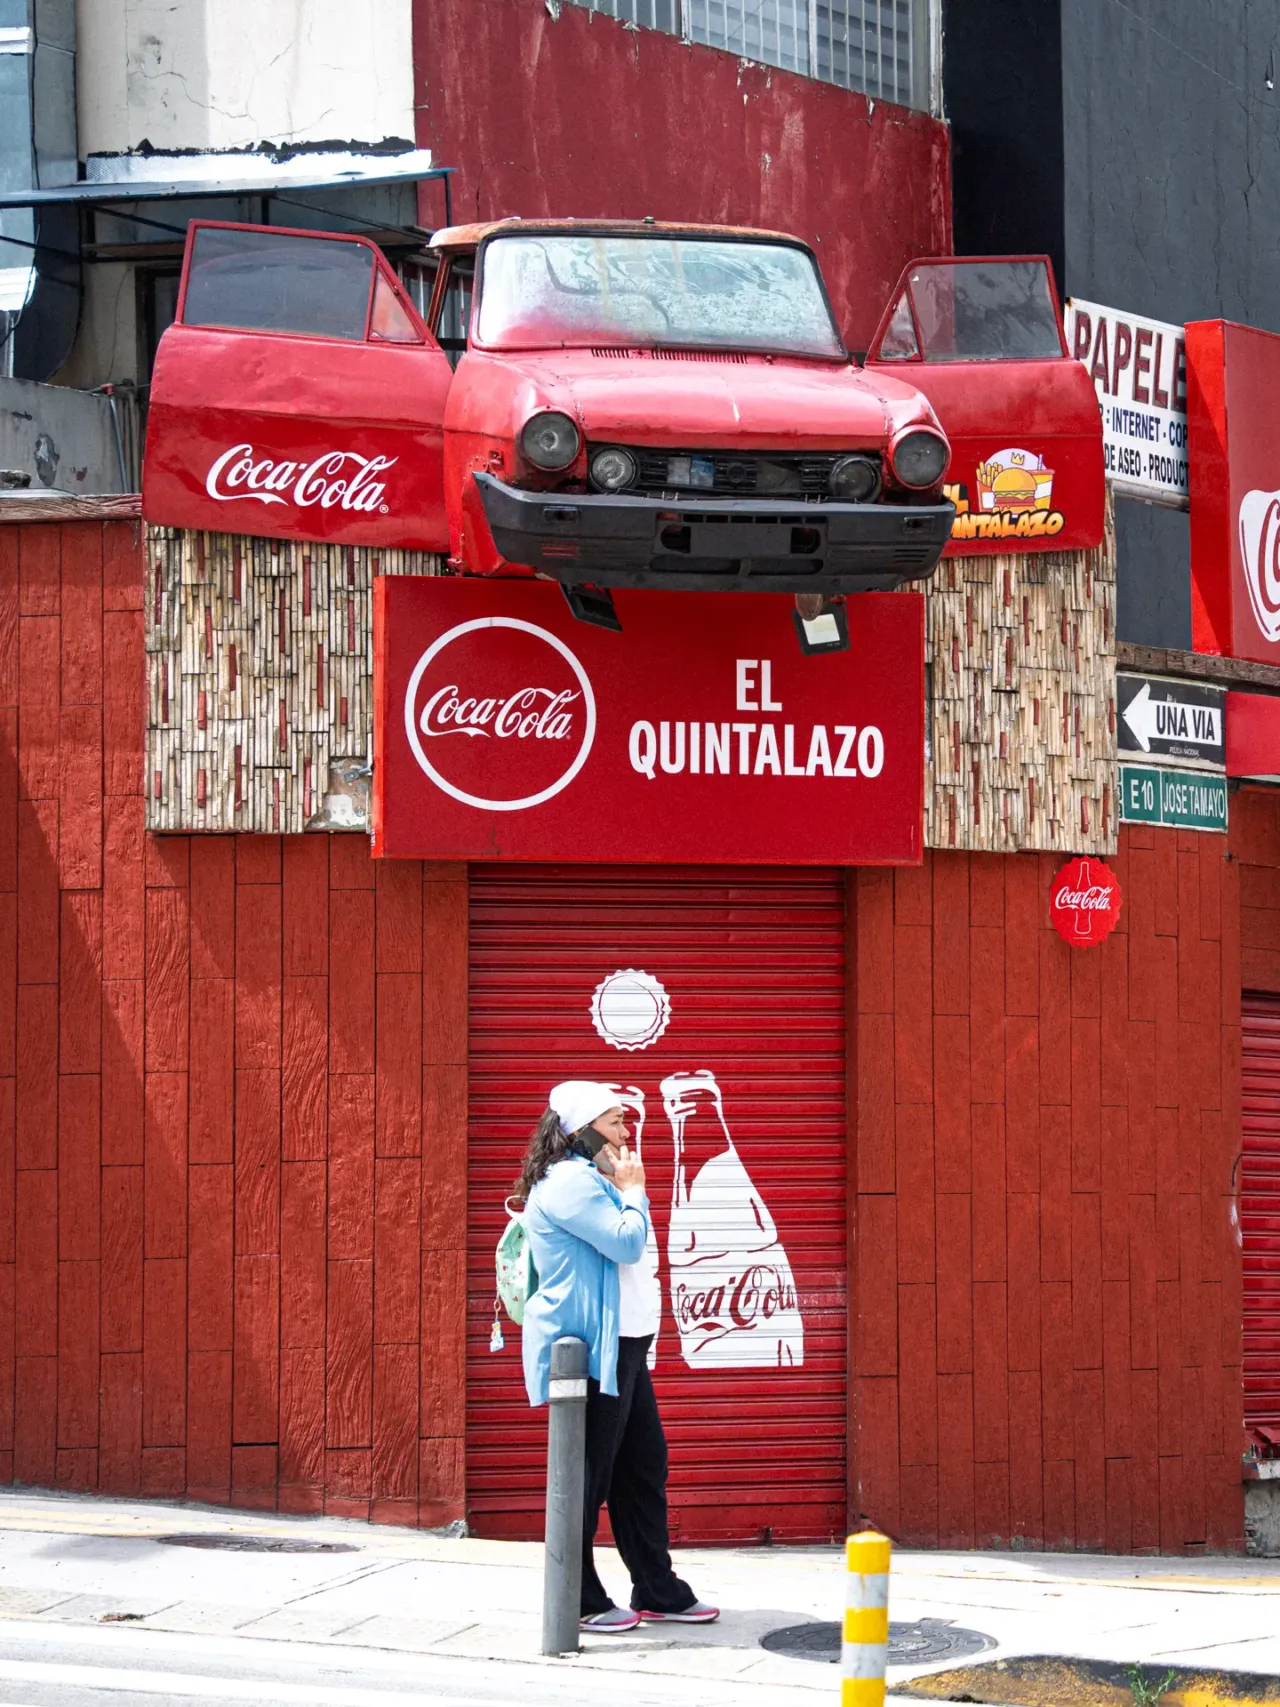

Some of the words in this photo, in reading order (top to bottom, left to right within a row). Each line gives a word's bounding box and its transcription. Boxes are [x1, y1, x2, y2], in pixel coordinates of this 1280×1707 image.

[1074, 310, 1186, 414] PAPELE
[1112, 406, 1160, 443] INTERNET
[206, 443, 399, 512] Coca-Cola
[1118, 446, 1141, 477] ASEO
[951, 512, 1063, 538] INTALAZO
[736, 659, 783, 711] EL
[419, 684, 582, 740] Coca-Cola
[1156, 704, 1189, 738] UNA
[1192, 708, 1216, 741] VIA
[628, 720, 884, 780] QUINTALAZO
[1130, 779, 1140, 809] E
[1141, 780, 1154, 811] 10
[1163, 783, 1188, 815] JOSE
[1189, 785, 1225, 819] TAMAYO
[1055, 886, 1114, 910] Coca-Cola
